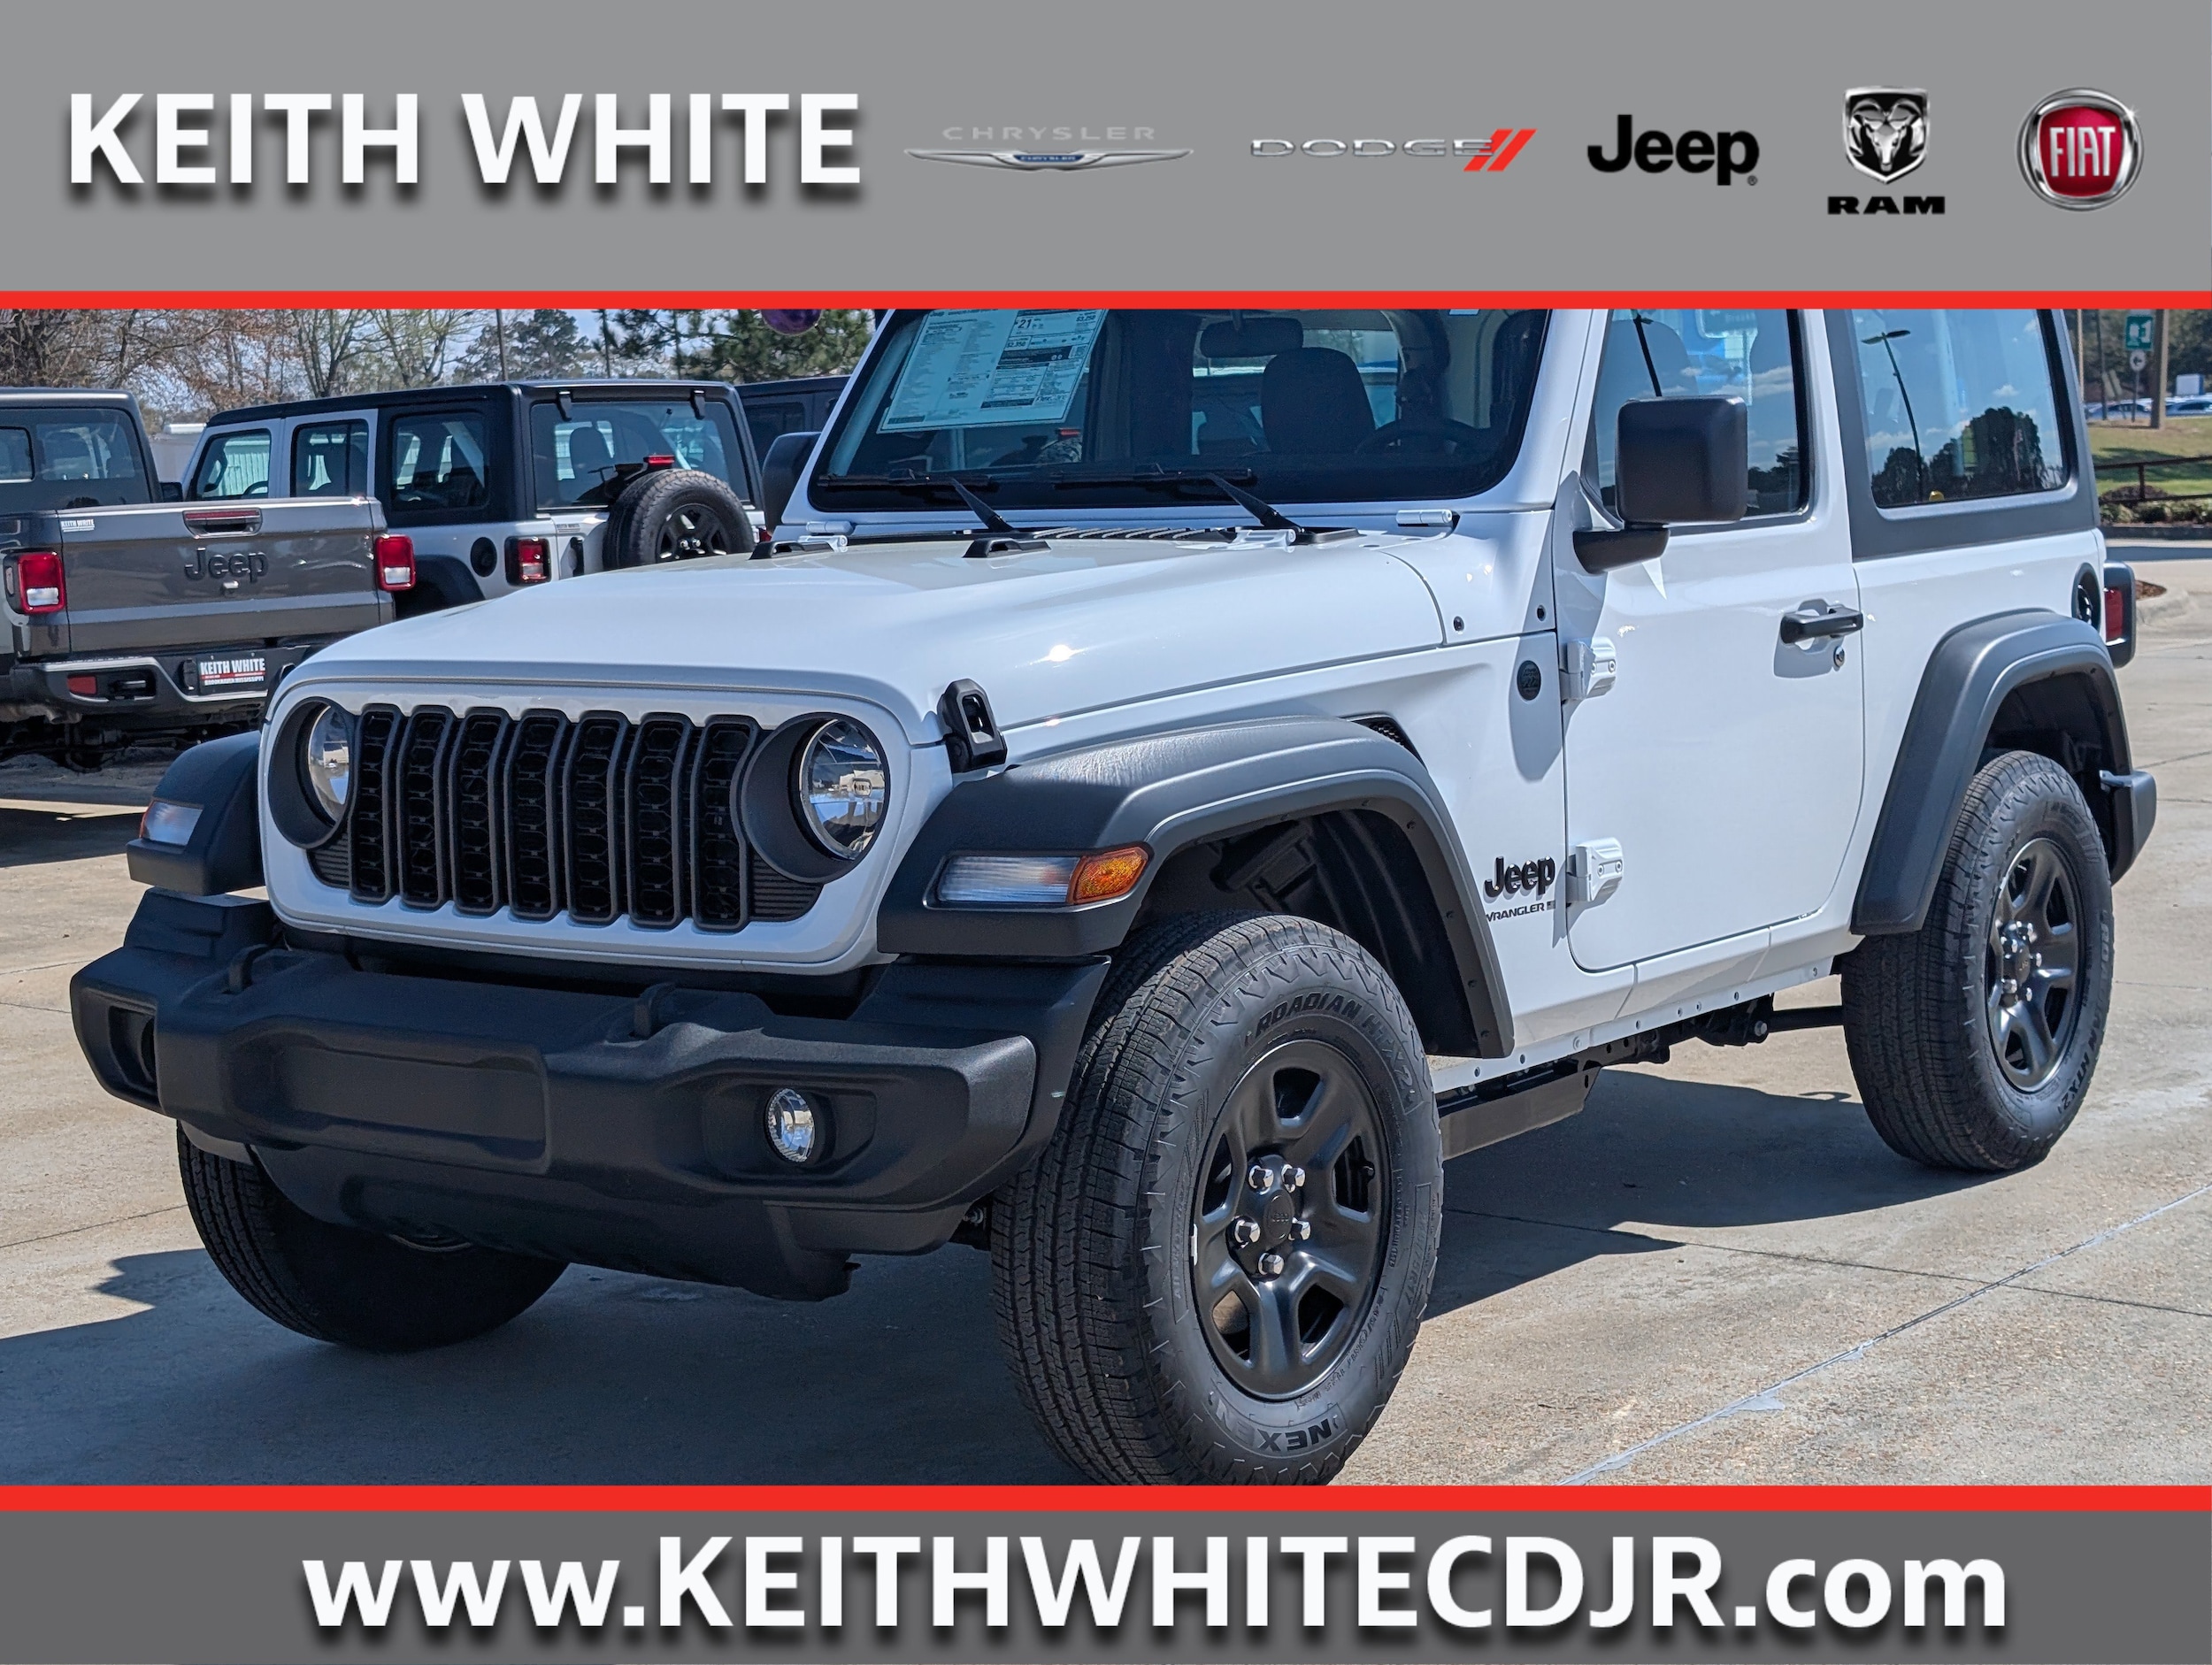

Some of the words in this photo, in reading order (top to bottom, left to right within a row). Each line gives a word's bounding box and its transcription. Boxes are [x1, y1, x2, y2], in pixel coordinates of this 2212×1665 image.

[1018, 318, 1033, 328] 21
[184, 547, 269, 584] Jeep
[200, 660, 231, 675] KEITH
[231, 657, 265, 673] WHITE
[1484, 856, 1556, 897] Jeep
[1255, 992, 1363, 1039] ROADIAN
[1216, 1398, 1333, 1452] NEXEN
